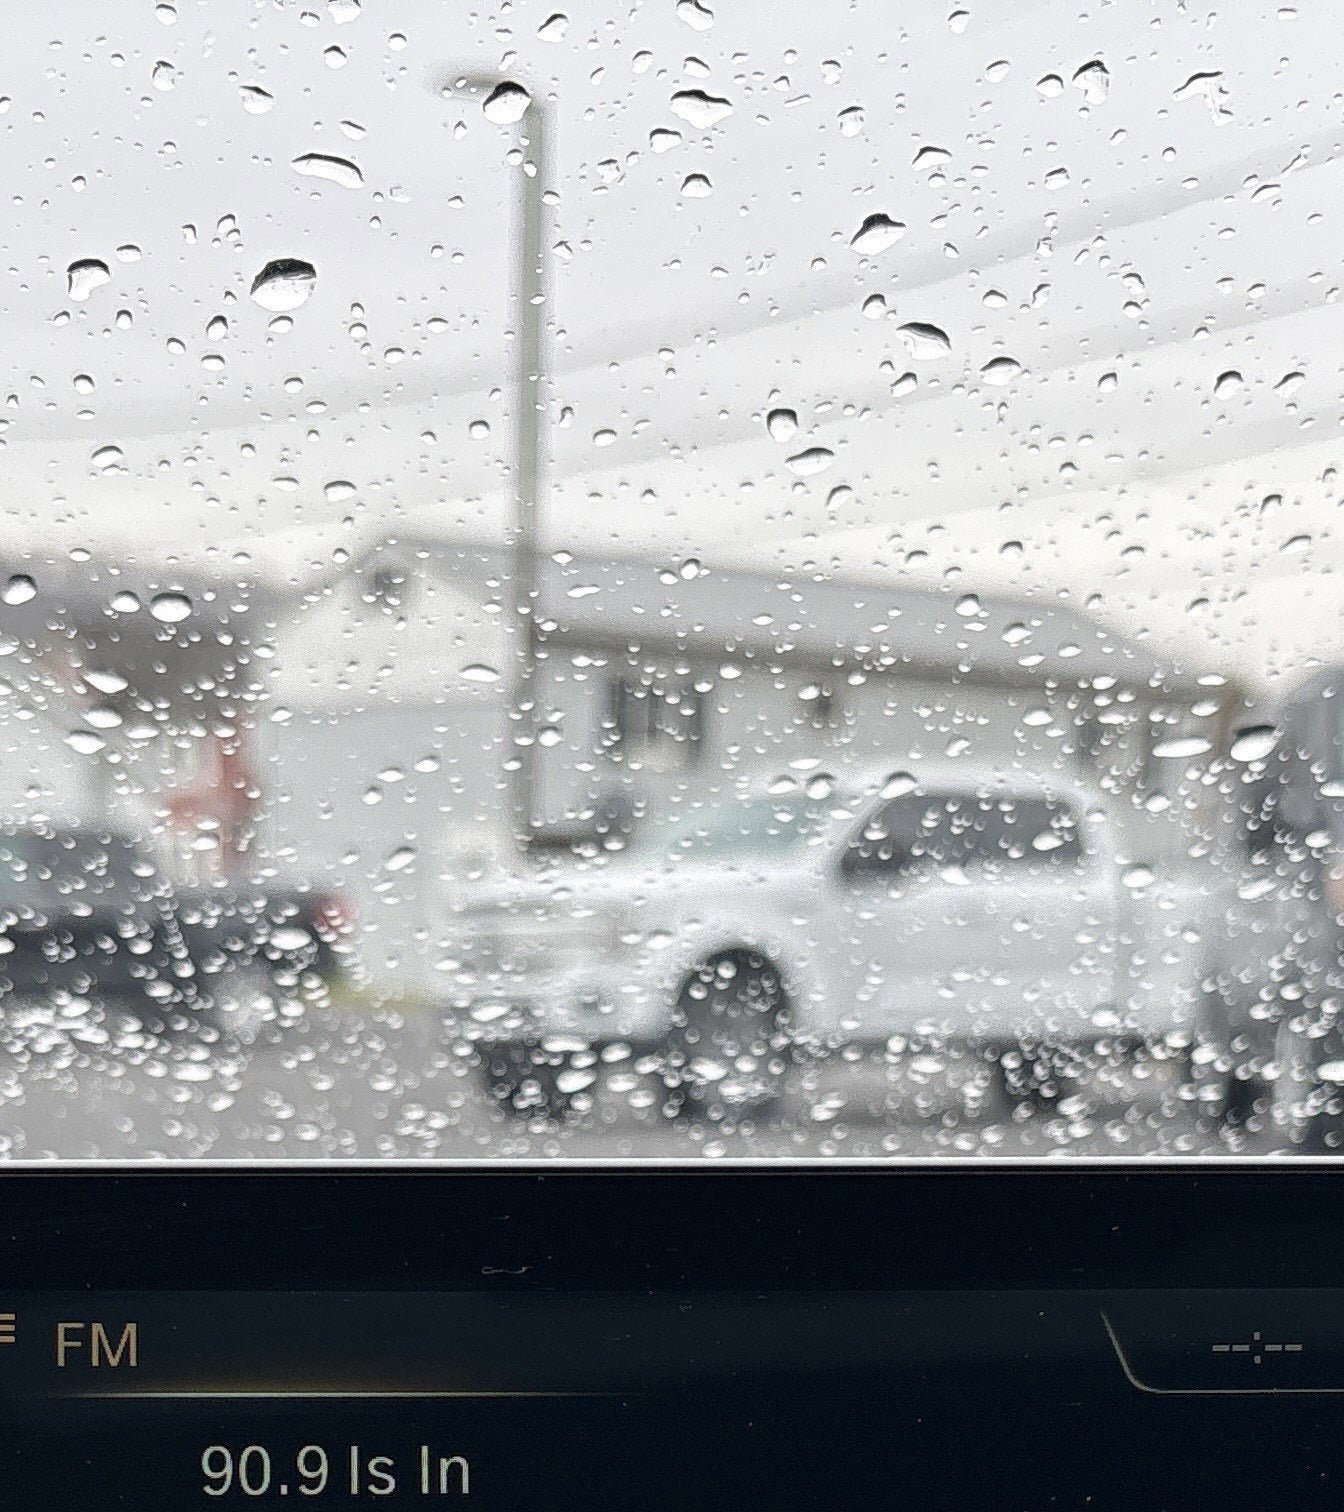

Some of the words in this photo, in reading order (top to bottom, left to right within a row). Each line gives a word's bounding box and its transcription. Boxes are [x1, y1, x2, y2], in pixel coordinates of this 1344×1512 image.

[57, 1322, 138, 1367] FM
[201, 1445, 329, 1496] 90.9
[350, 1445, 396, 1495] Is
[420, 1445, 469, 1495] In
